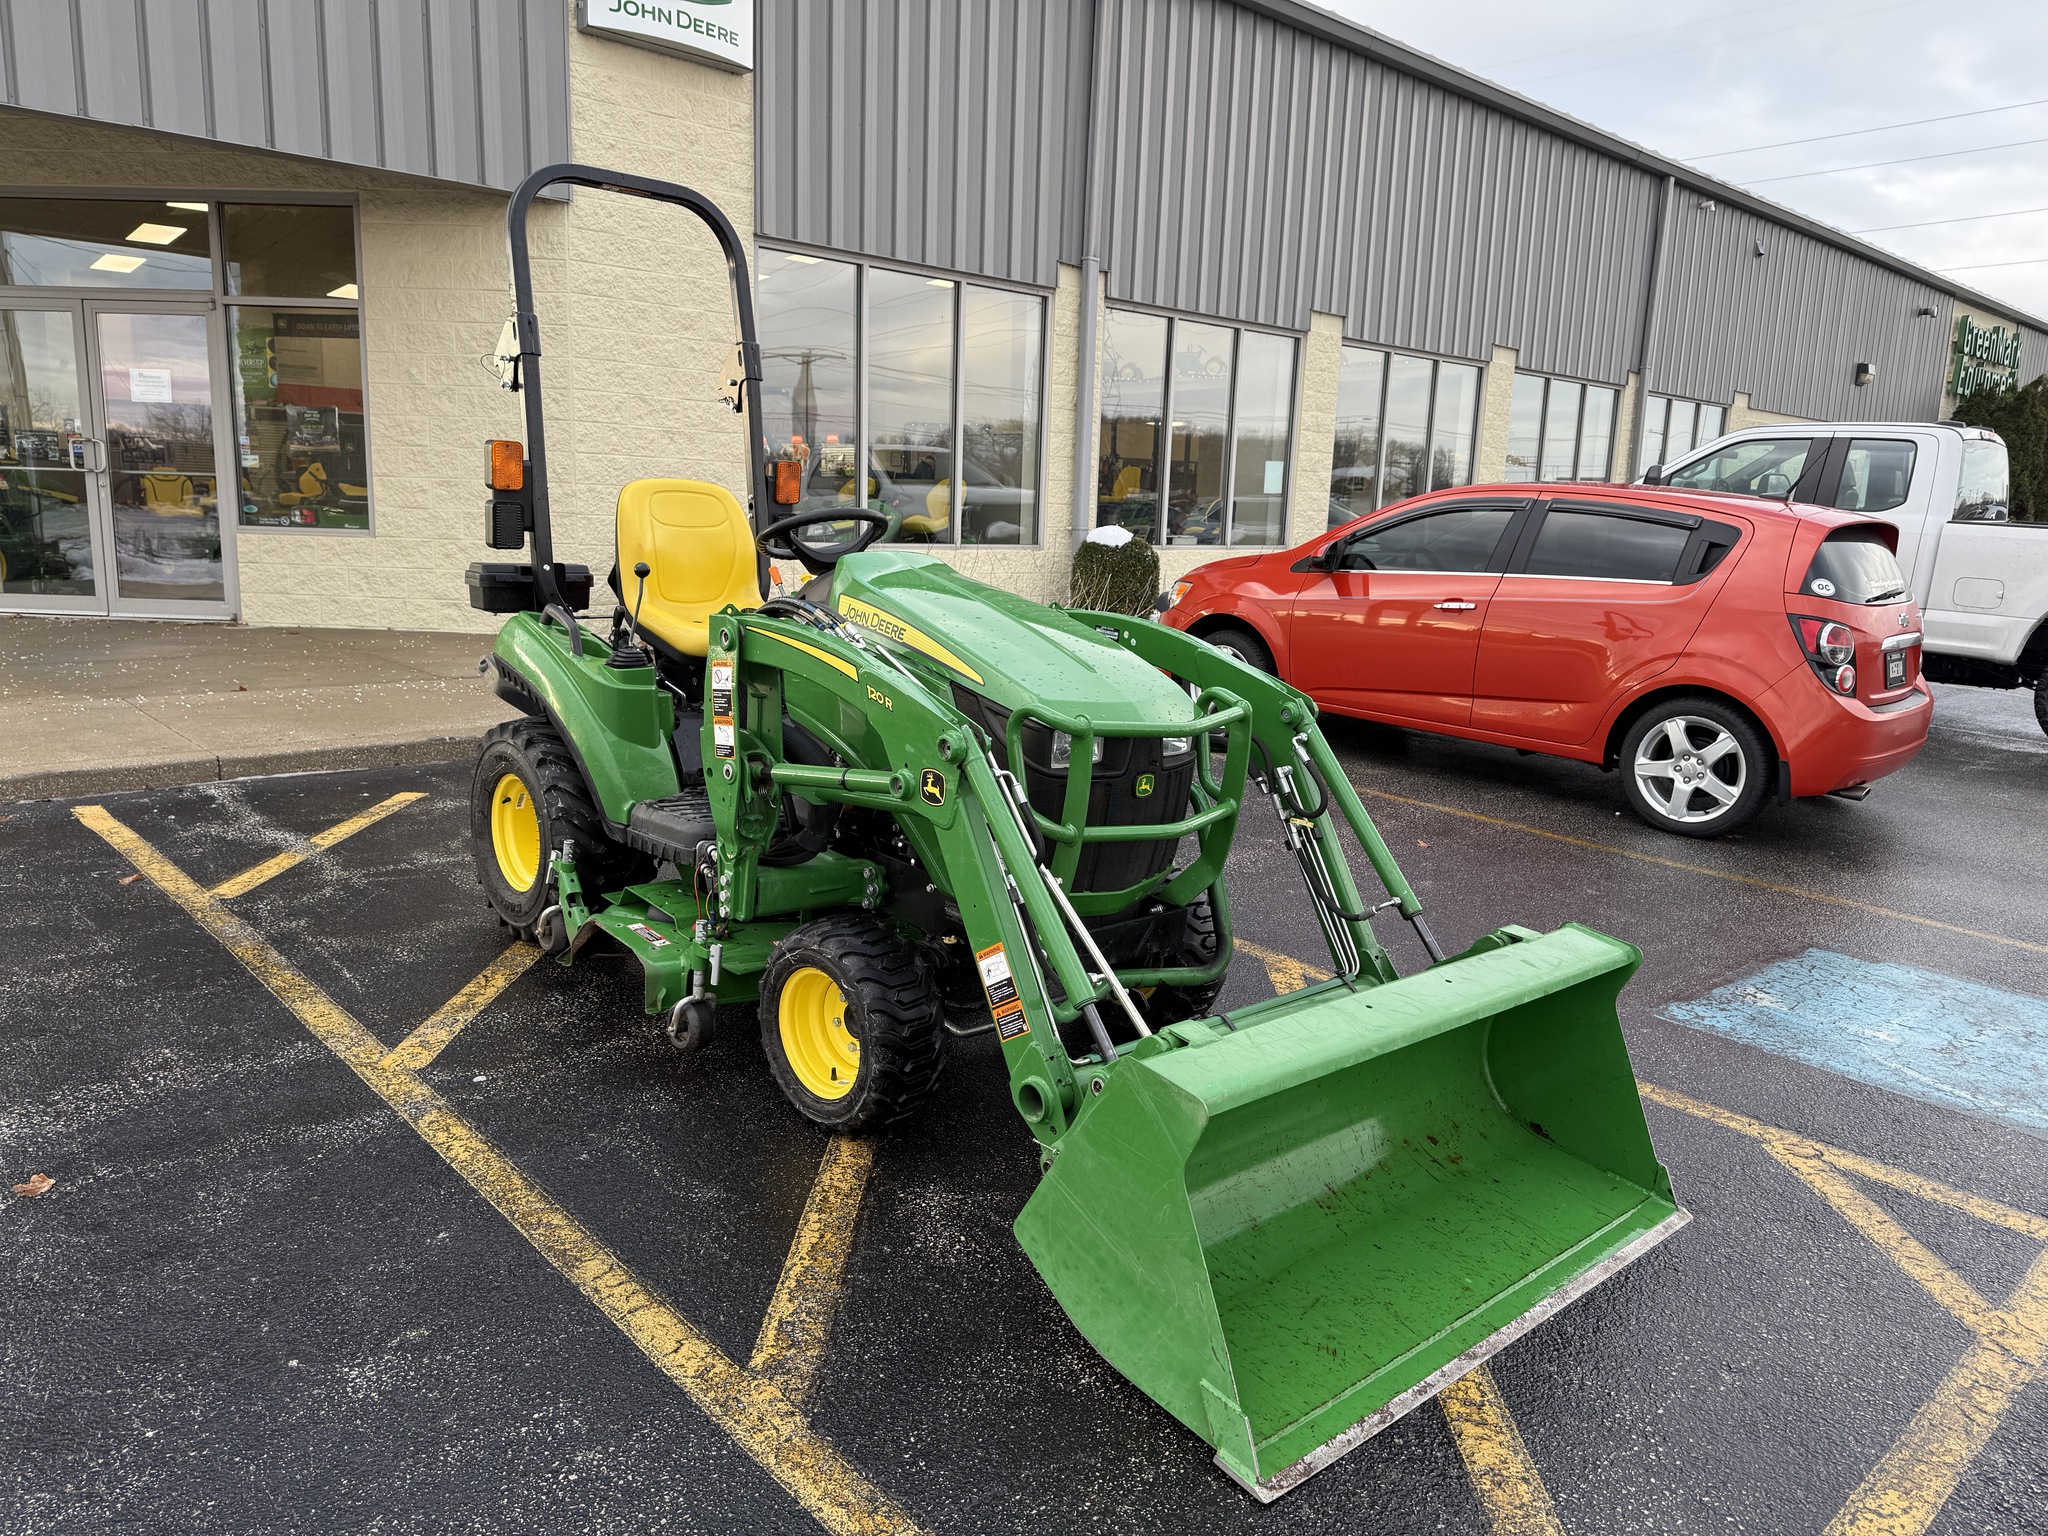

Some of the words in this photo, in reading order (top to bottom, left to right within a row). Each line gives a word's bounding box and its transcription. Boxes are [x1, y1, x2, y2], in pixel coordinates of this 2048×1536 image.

[609, 0, 672, 25] JOHN
[677, 9, 740, 47] DEERE
[296, 322, 315, 330] DOWN
[324, 323, 343, 331] EARTH
[1963, 314, 2023, 369] GreenMark
[1817, 583, 1831, 592] OC
[843, 603, 870, 626] JOHN
[870, 612, 907, 641] DEERE
[983, 945, 1001, 957] WARNING
[1001, 1003, 1020, 1014] WARNING
